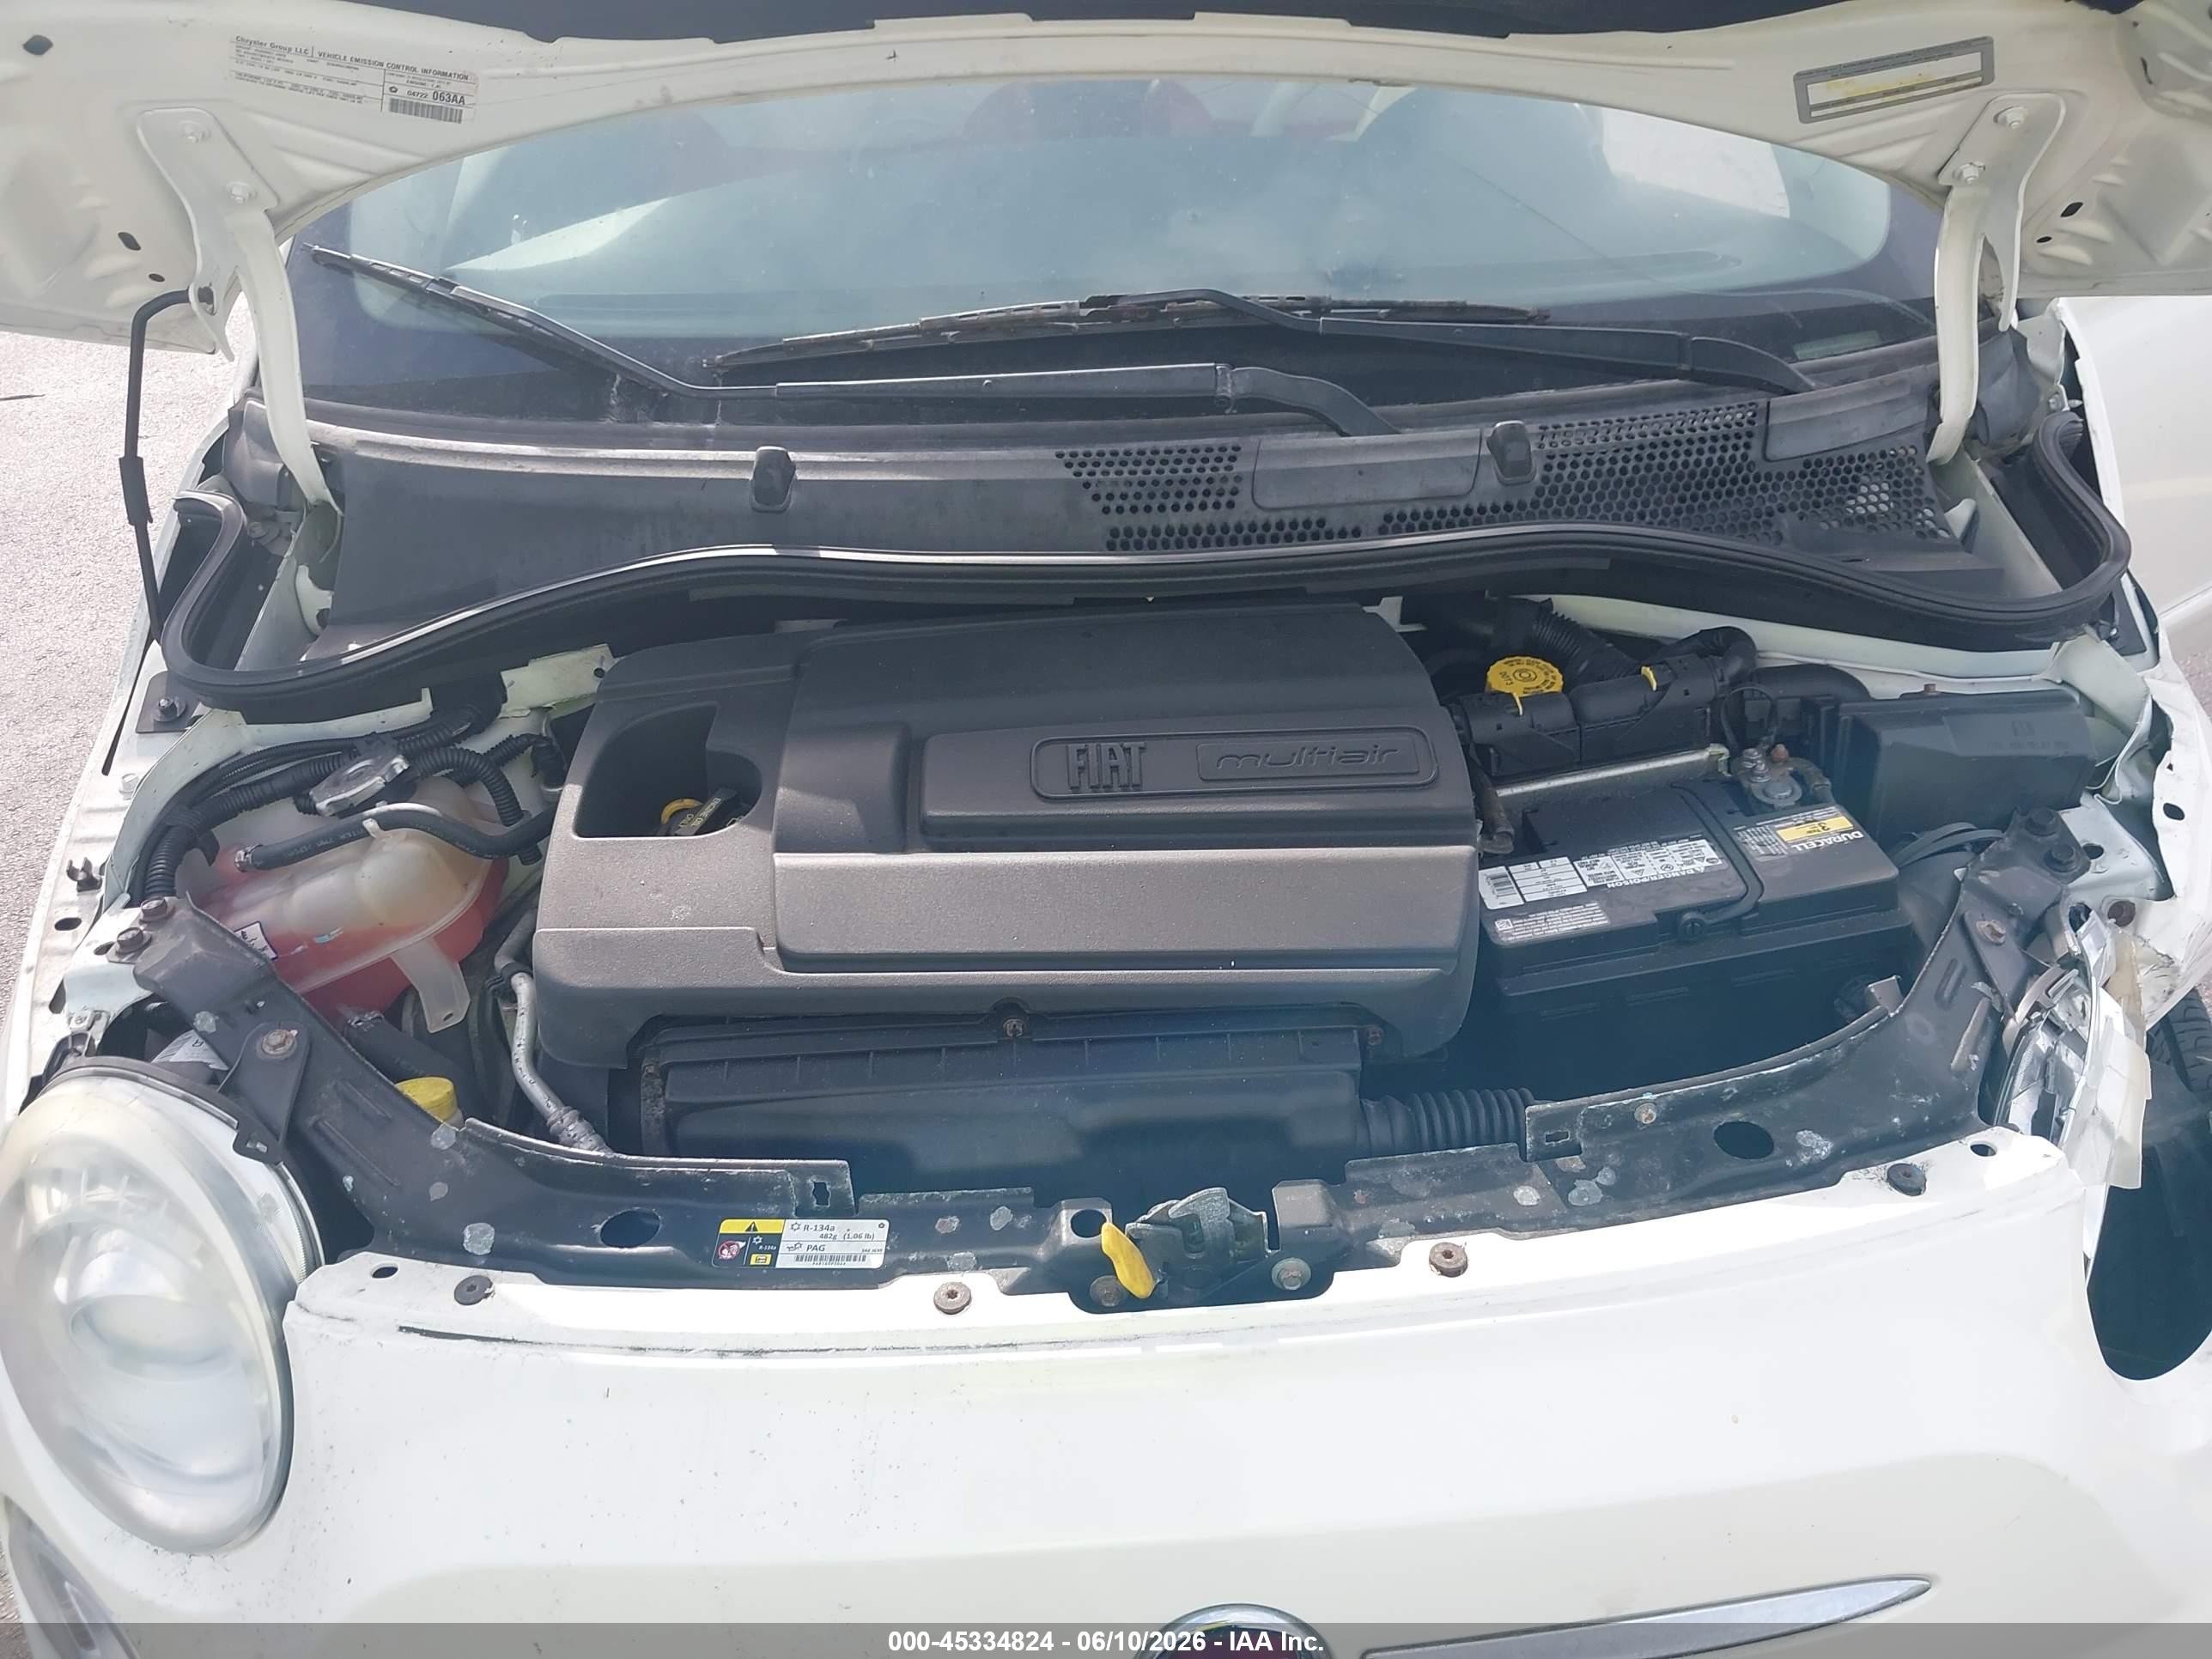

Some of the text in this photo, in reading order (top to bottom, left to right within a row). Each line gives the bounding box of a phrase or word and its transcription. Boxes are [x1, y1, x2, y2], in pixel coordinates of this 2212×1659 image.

[235, 35, 267, 46] Chrysler
[270, 42, 292, 53] Group
[318, 51, 348, 62] VEHICLE
[349, 56, 384, 67] EMISSION
[386, 62, 418, 73] CONTROL
[421, 68, 469, 81] INFORMATION
[432, 90, 465, 105] 063AA
[1066, 742, 1401, 790] FIAT multiair
[1818, 822, 1830, 831] 3
[1790, 830, 1864, 851] DURACELL
[843, 1232, 862, 1241] (1.06
[864, 1232, 875, 1241] lb)
